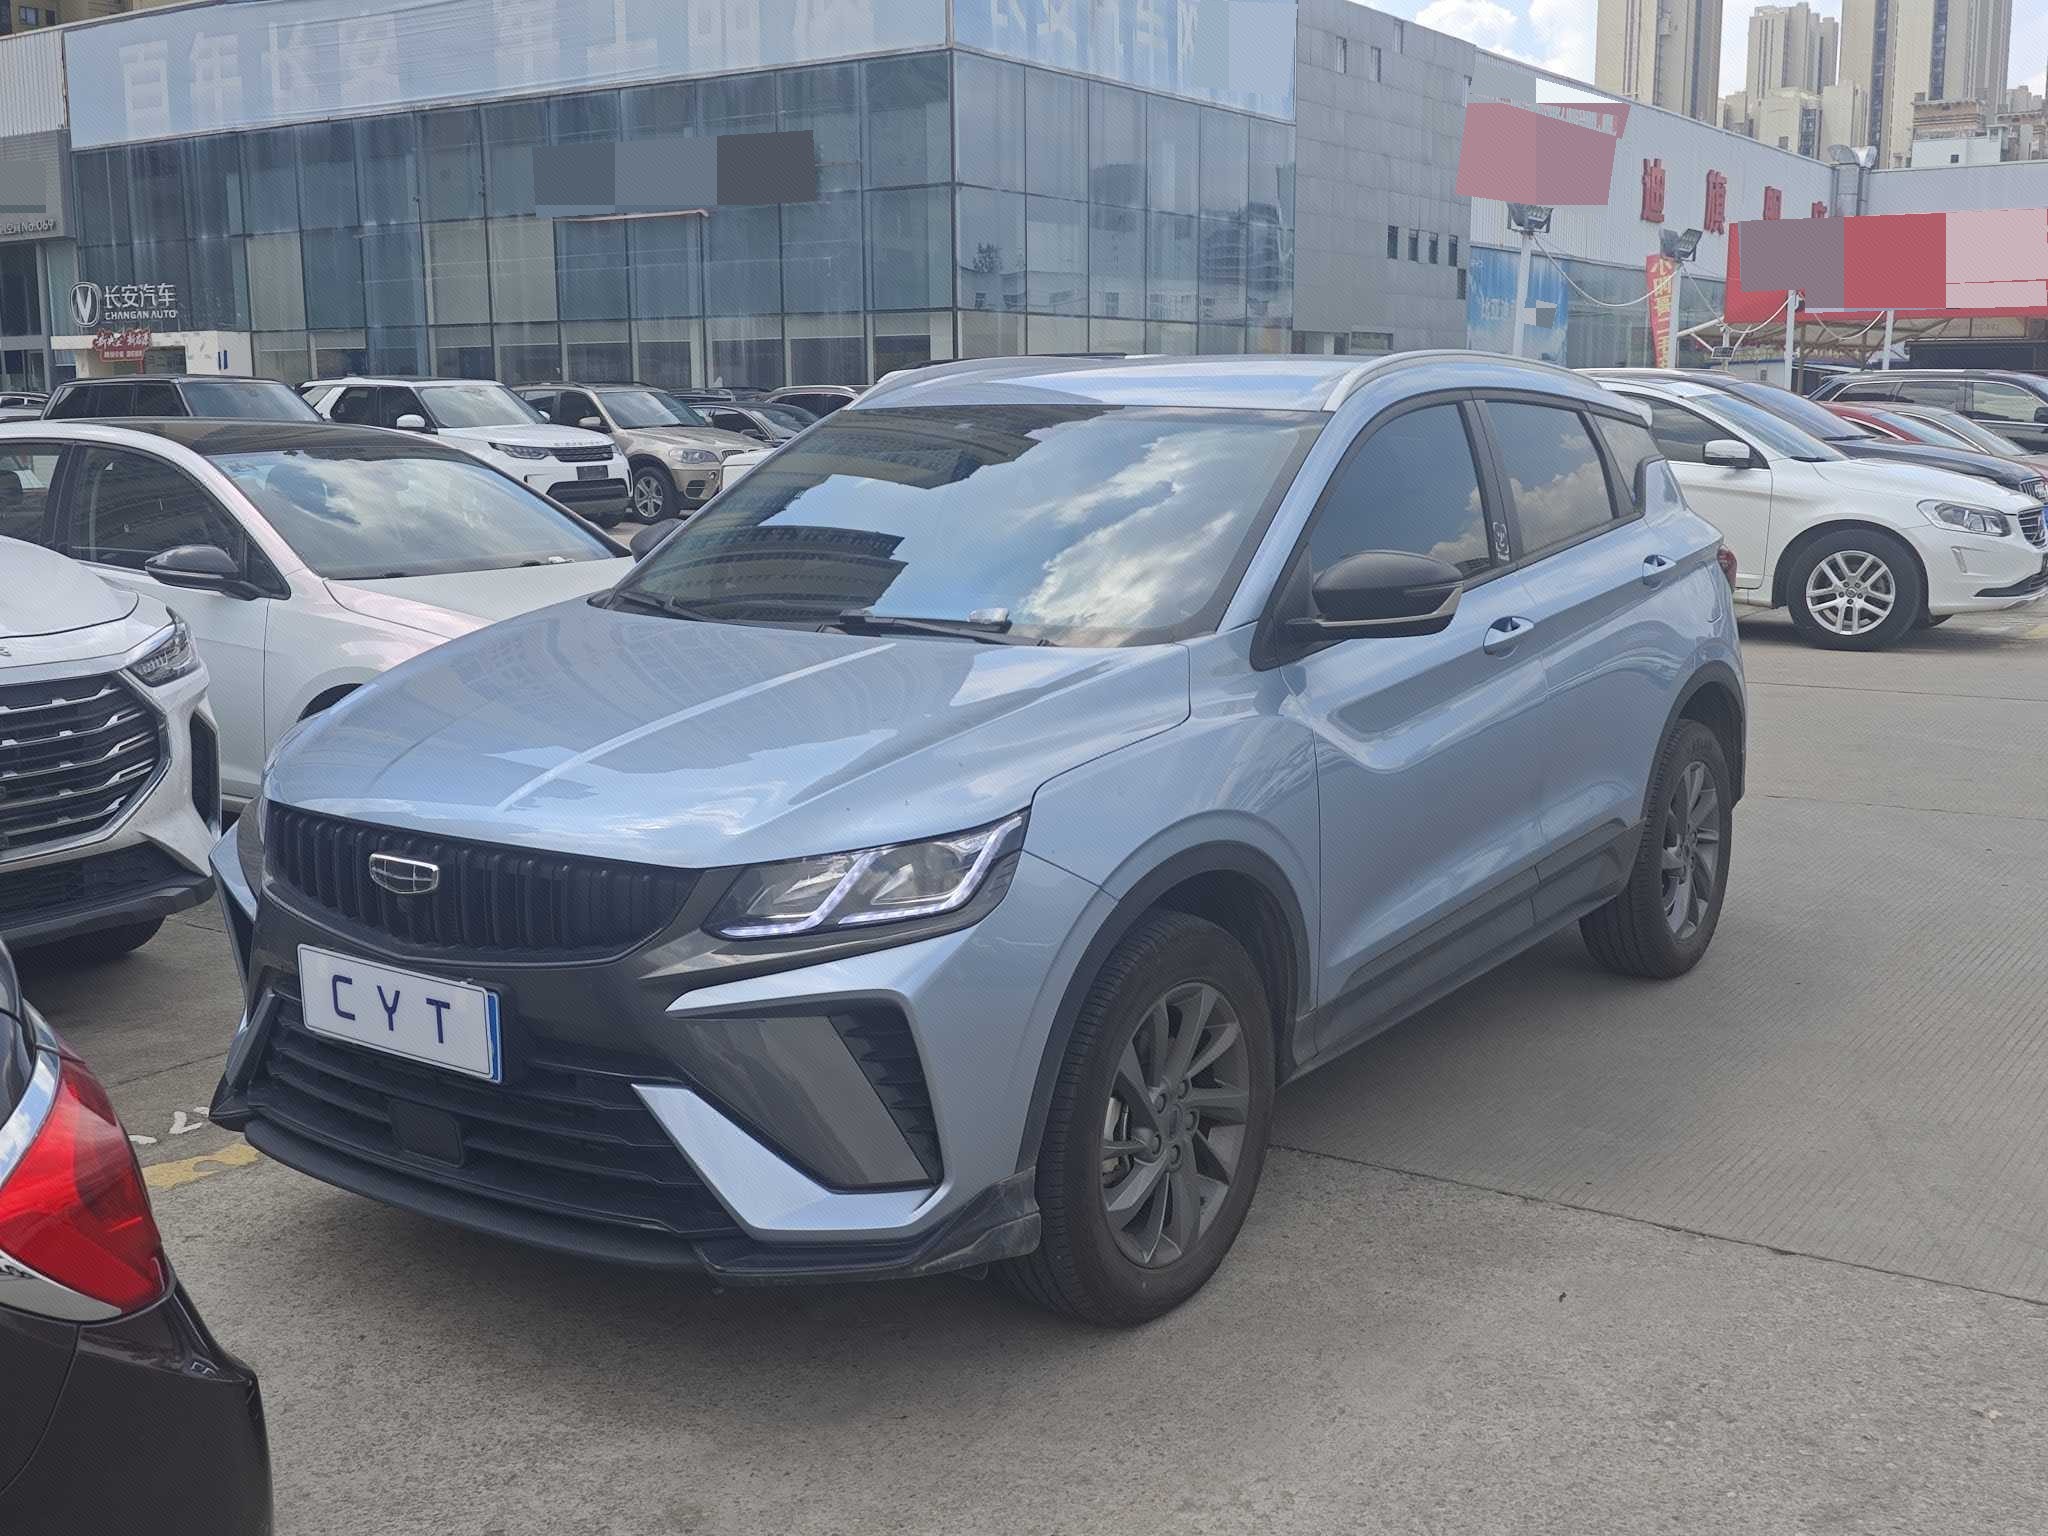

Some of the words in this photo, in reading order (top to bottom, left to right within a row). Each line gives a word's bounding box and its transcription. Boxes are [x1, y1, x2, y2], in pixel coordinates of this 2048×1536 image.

[104, 283, 177, 308] 长安汽车
[105, 310, 149, 320] CHANGAN
[150, 310, 177, 319] AUTO
